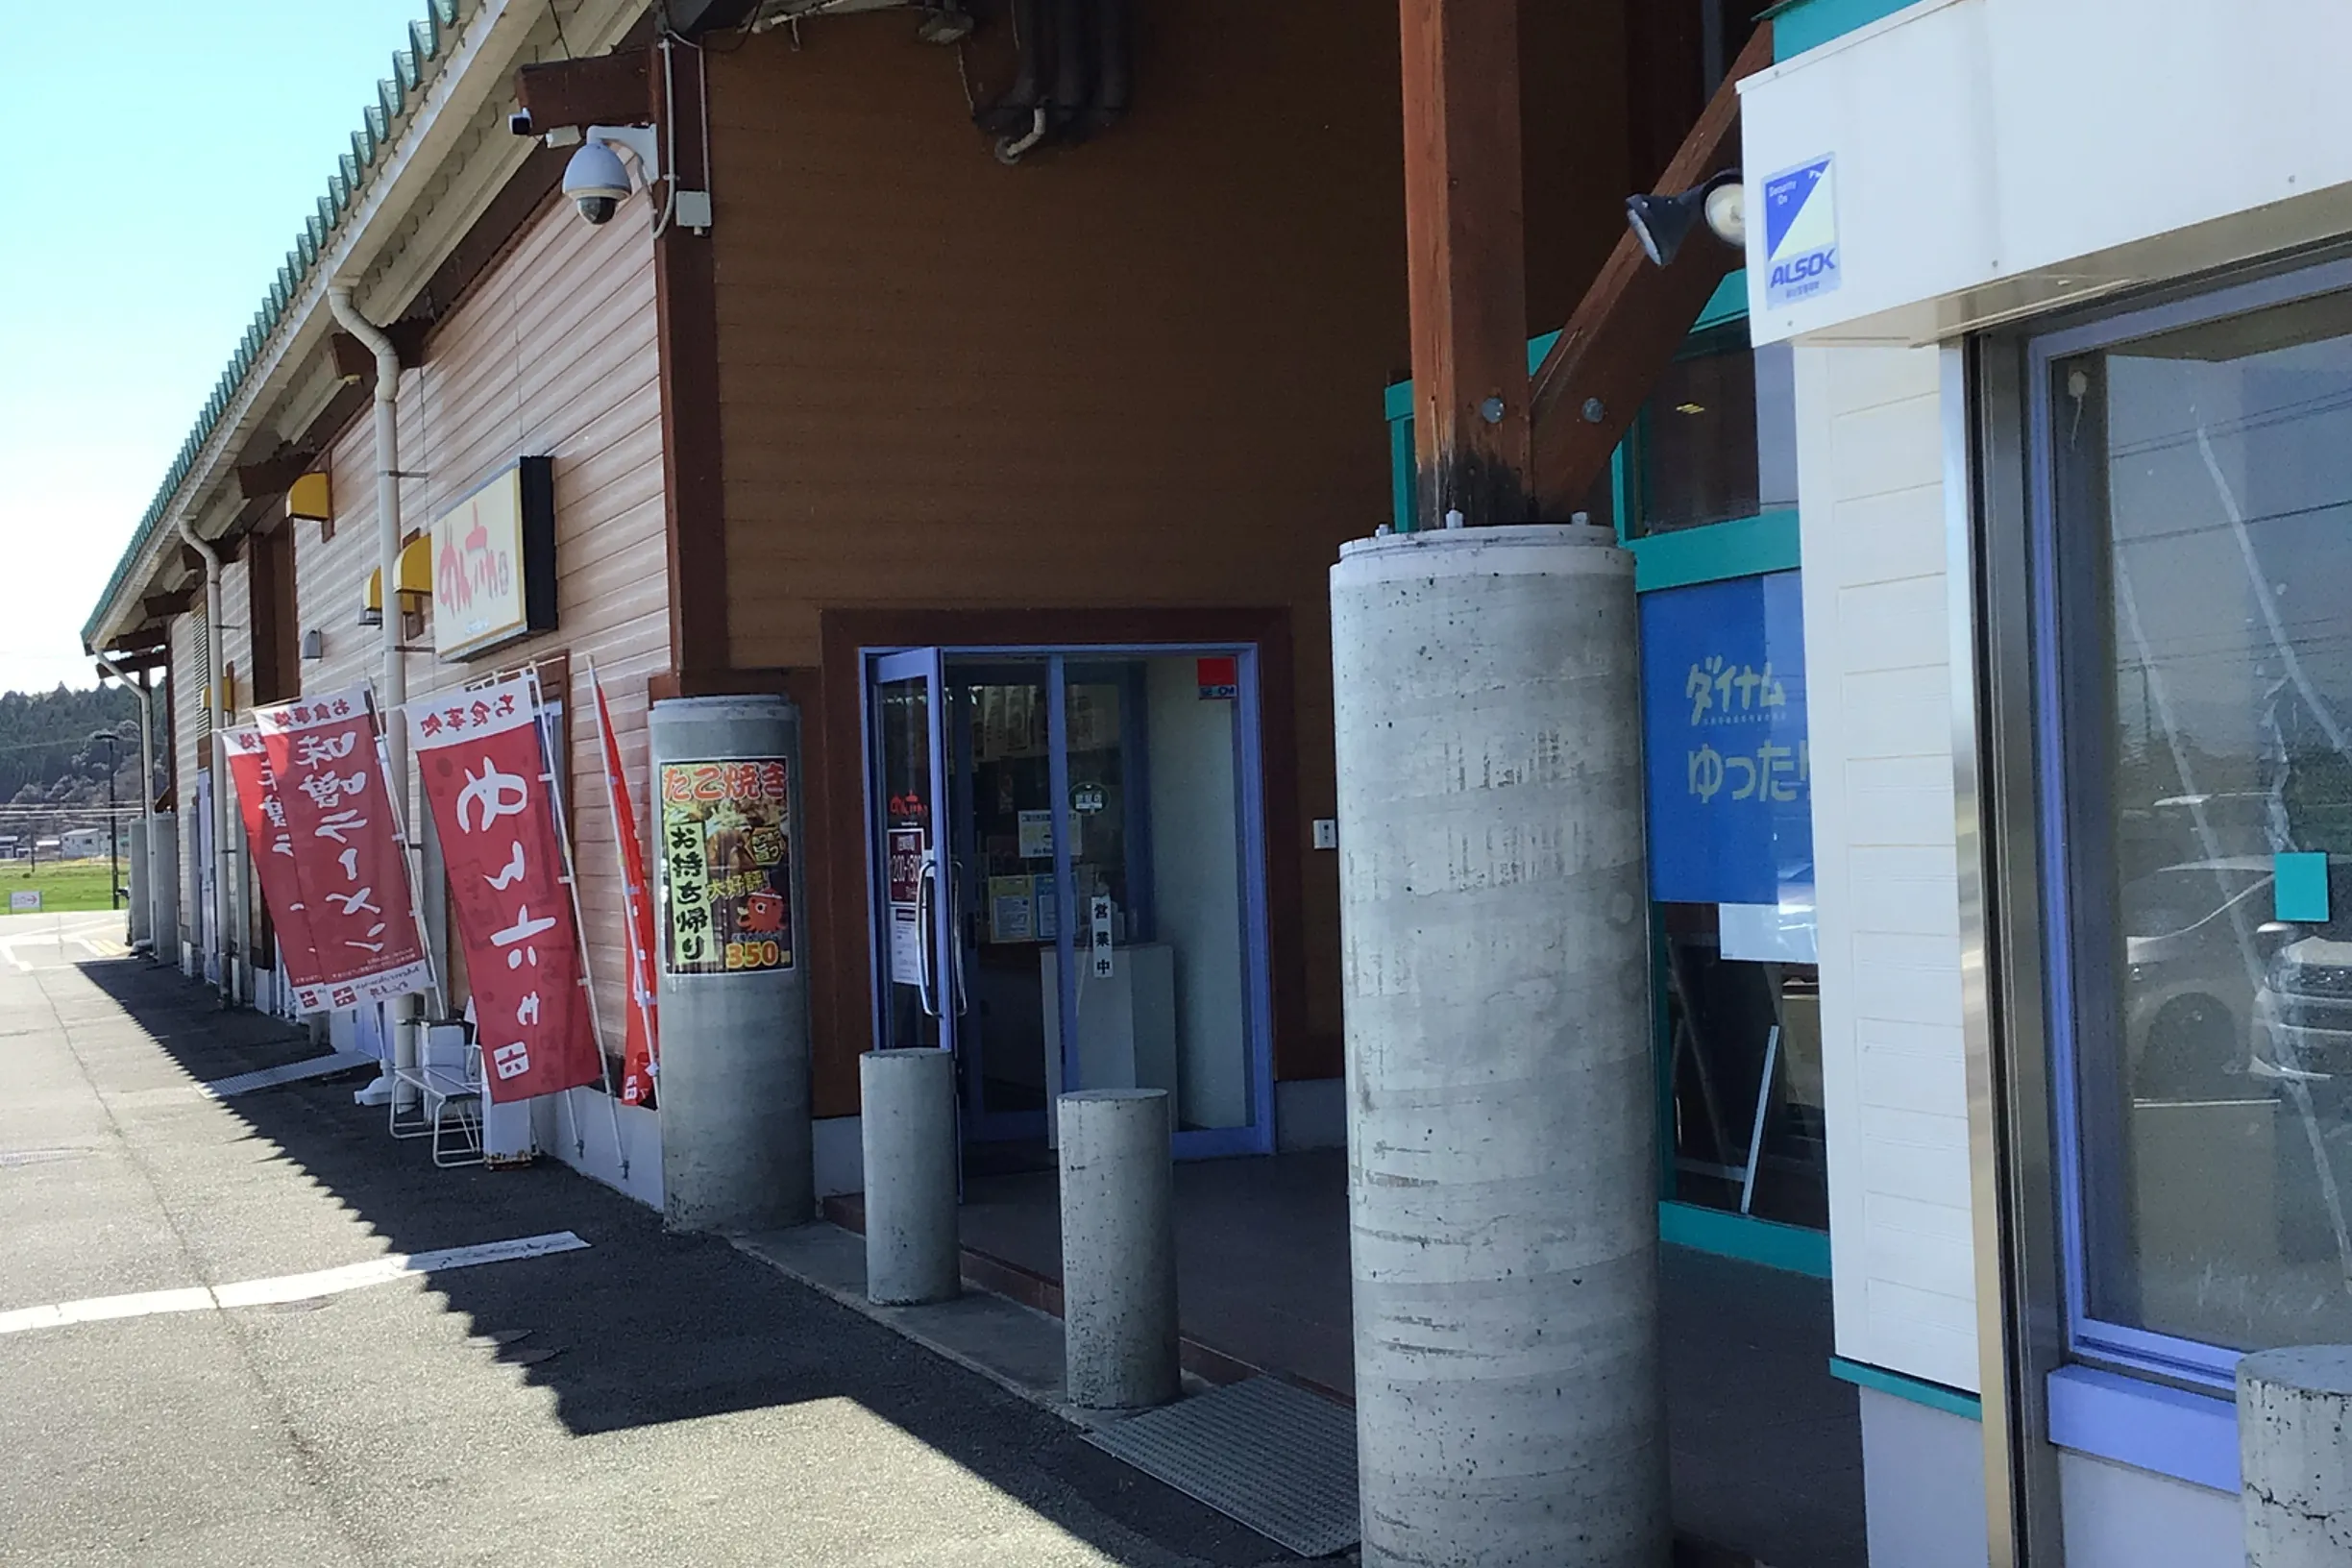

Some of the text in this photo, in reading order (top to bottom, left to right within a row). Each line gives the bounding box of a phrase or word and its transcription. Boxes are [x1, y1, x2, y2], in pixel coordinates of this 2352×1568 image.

[1770, 247, 1836, 288] ALSOK
[1686, 655, 1786, 725] ダイナム
[663, 762, 787, 801] たこ焼き
[670, 826, 708, 961] お持ち帰り
[1094, 903, 1111, 974] 営業中
